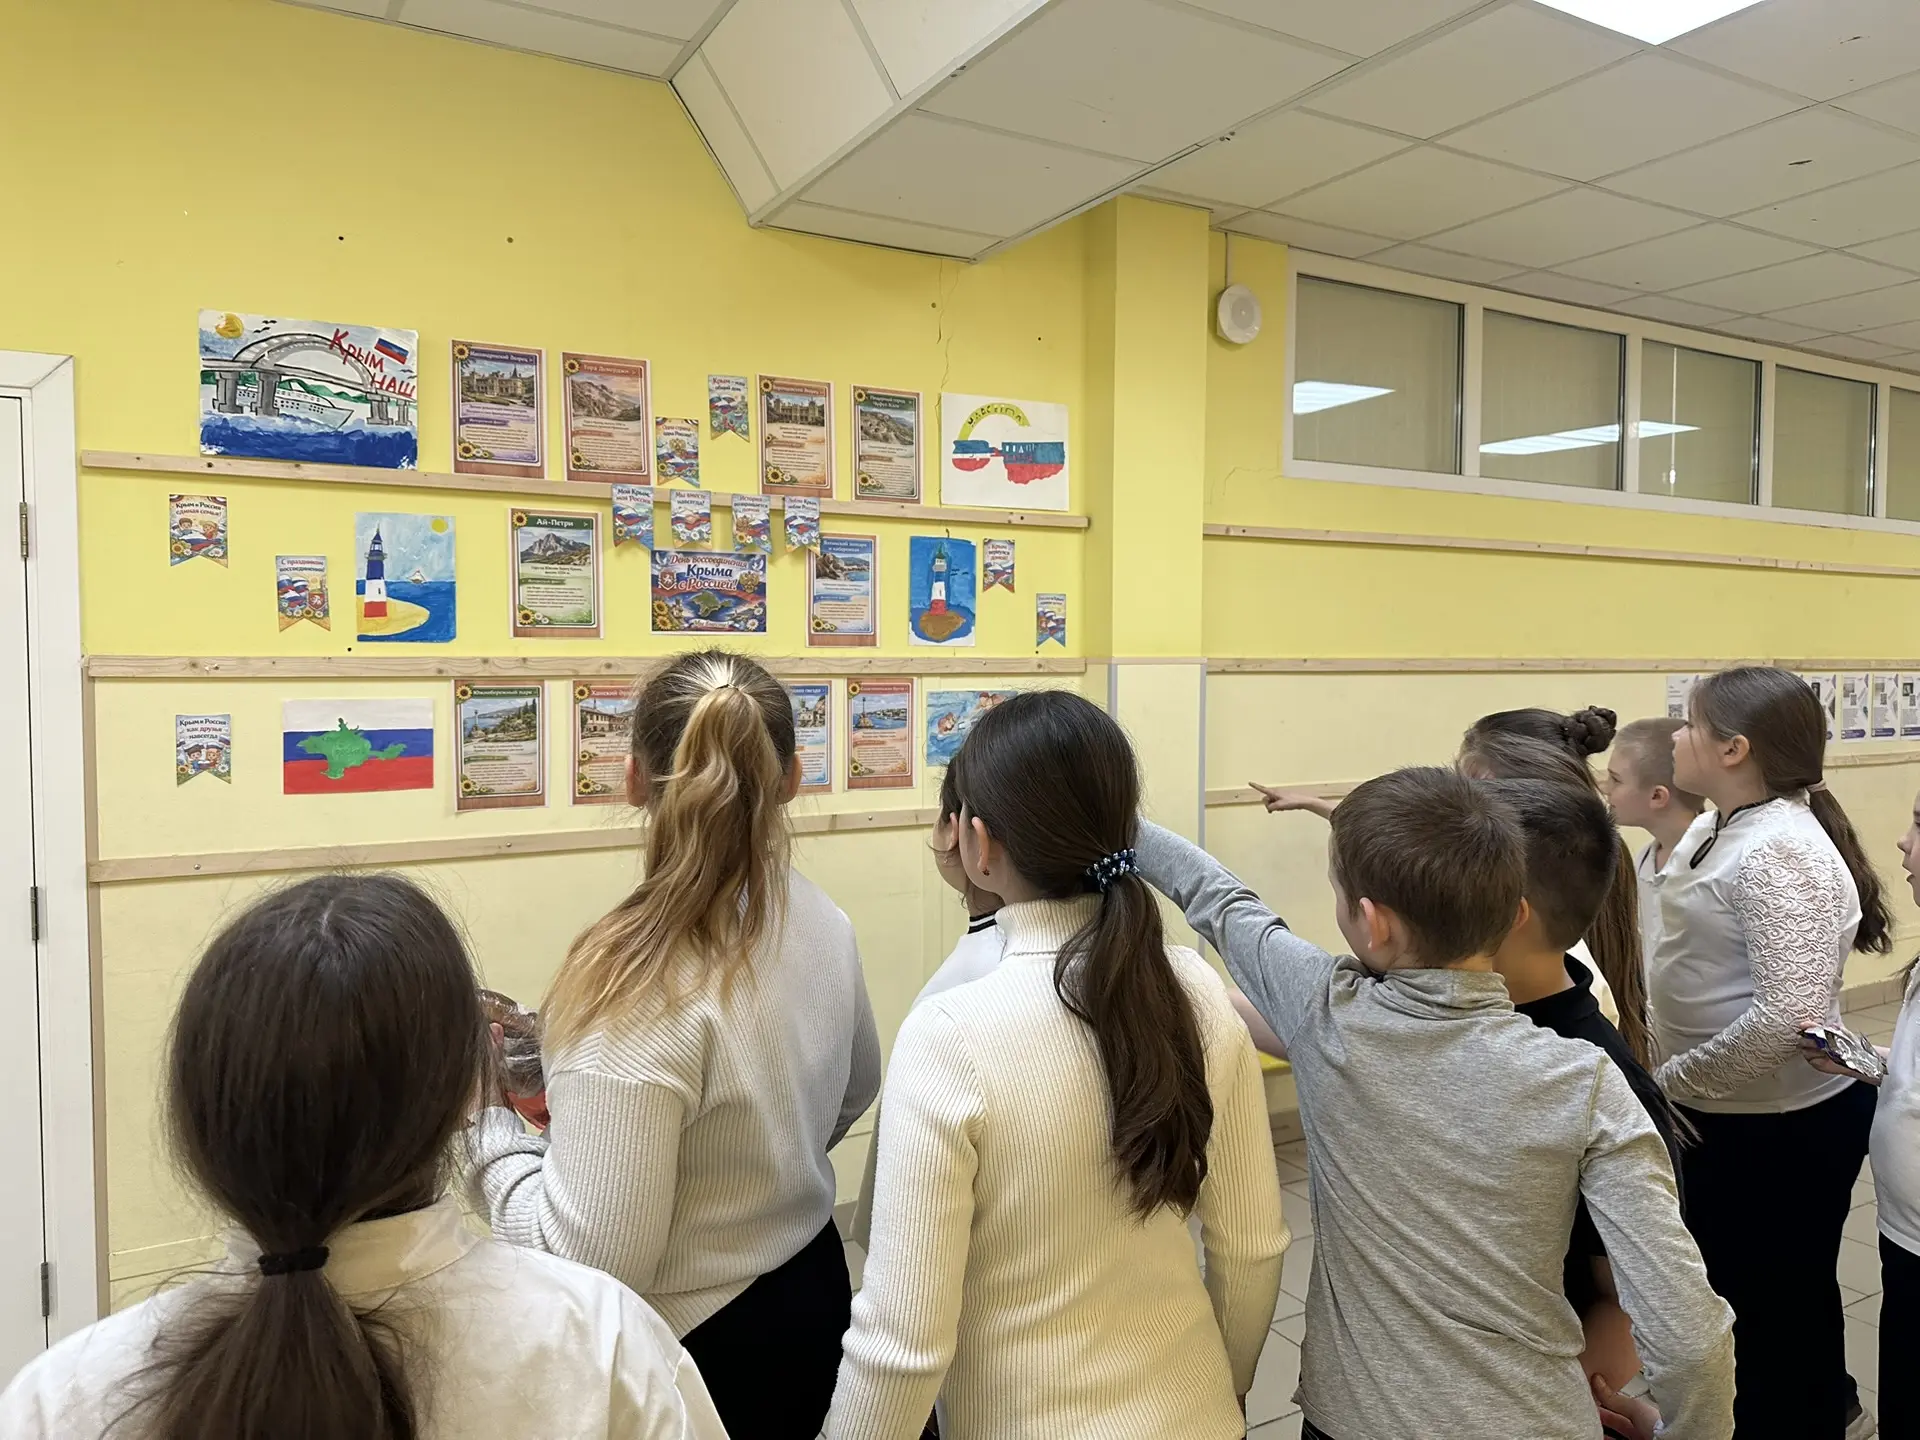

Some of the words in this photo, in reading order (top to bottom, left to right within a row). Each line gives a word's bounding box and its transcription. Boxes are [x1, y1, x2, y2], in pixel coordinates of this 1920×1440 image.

[536, 518, 574, 528] Ай-Петри
[670, 555, 690, 565] День
[691, 555, 748, 568] воссоединения
[686, 564, 733, 579] Крыма
[678, 581, 686, 590] с
[686, 577, 738, 590] Россией!
[180, 719, 200, 727] Крым
